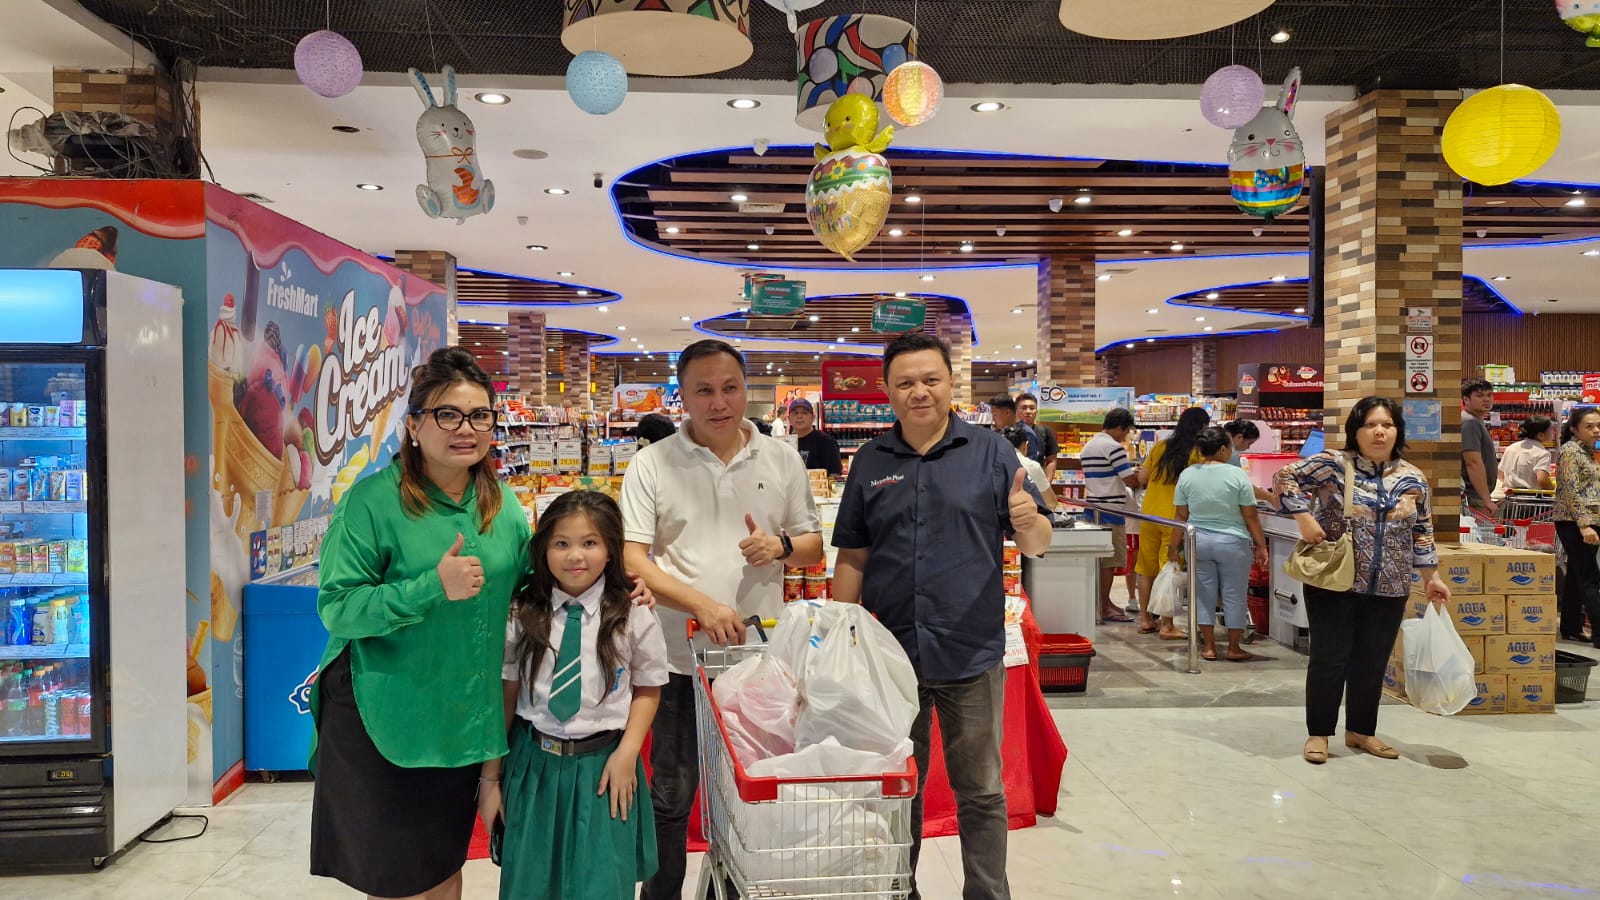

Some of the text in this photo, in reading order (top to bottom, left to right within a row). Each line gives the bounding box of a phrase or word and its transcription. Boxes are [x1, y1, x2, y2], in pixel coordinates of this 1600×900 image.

[267, 277, 319, 318] FreshMart
[338, 288, 382, 374] Ice
[316, 344, 410, 457] Cream
[1448, 567, 1470, 576] AQUA
[1506, 562, 1536, 575] AQUA
[1457, 602, 1486, 615] AQUA
[1521, 606, 1543, 615] AQUA
[1506, 642, 1536, 654] AQUA
[1521, 685, 1543, 694] AQUA
